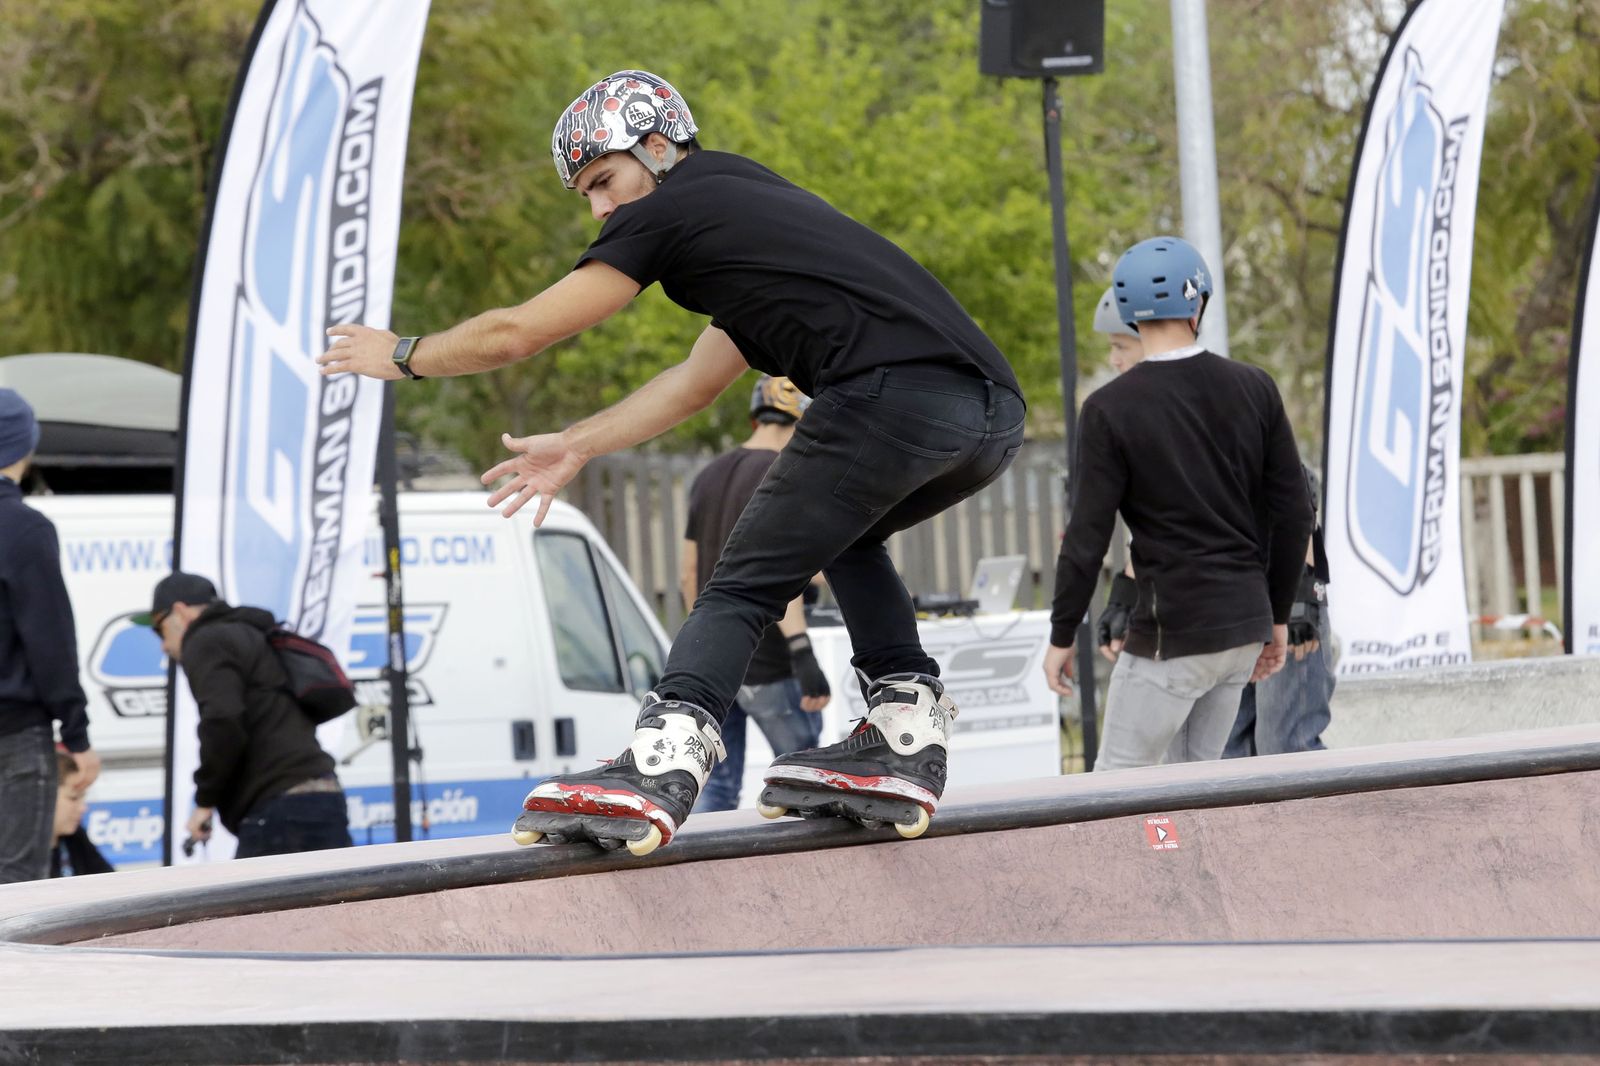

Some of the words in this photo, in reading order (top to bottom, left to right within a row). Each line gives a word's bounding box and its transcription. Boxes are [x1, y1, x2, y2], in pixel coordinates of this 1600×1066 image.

[322, 86, 379, 415] SNIDO.COM
[1429, 119, 1467, 388] SONIDO.COM
[296, 416, 350, 638] GERMAN
[1420, 397, 1451, 575] GERMAN
